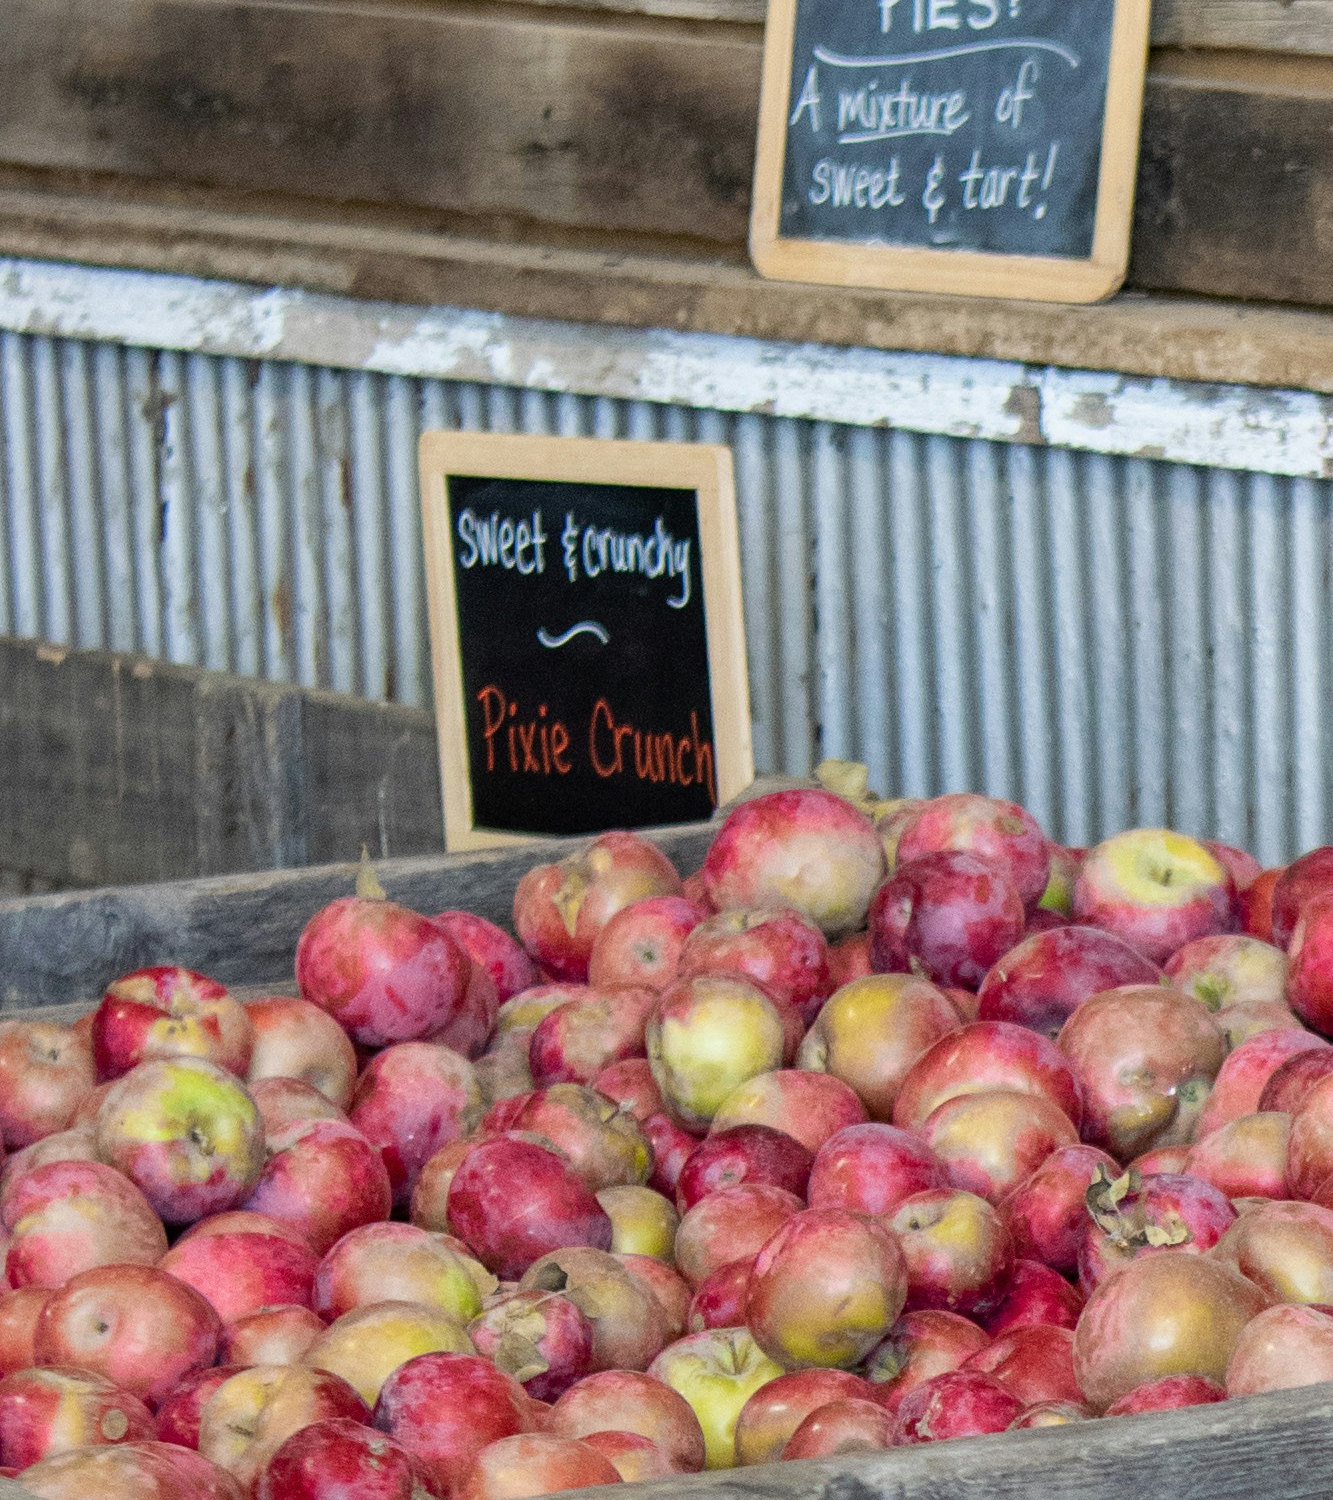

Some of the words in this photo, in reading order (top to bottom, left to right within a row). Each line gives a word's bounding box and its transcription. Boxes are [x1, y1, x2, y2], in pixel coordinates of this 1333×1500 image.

[789, 64, 821, 133] A
[838, 79, 970, 134] mixture
[994, 57, 1040, 129] of
[808, 157, 905, 210] sweet
[959, 143, 1060, 219] tart!
[476, 684, 573, 775] Pixie
[589, 697, 717, 805] Crunch
